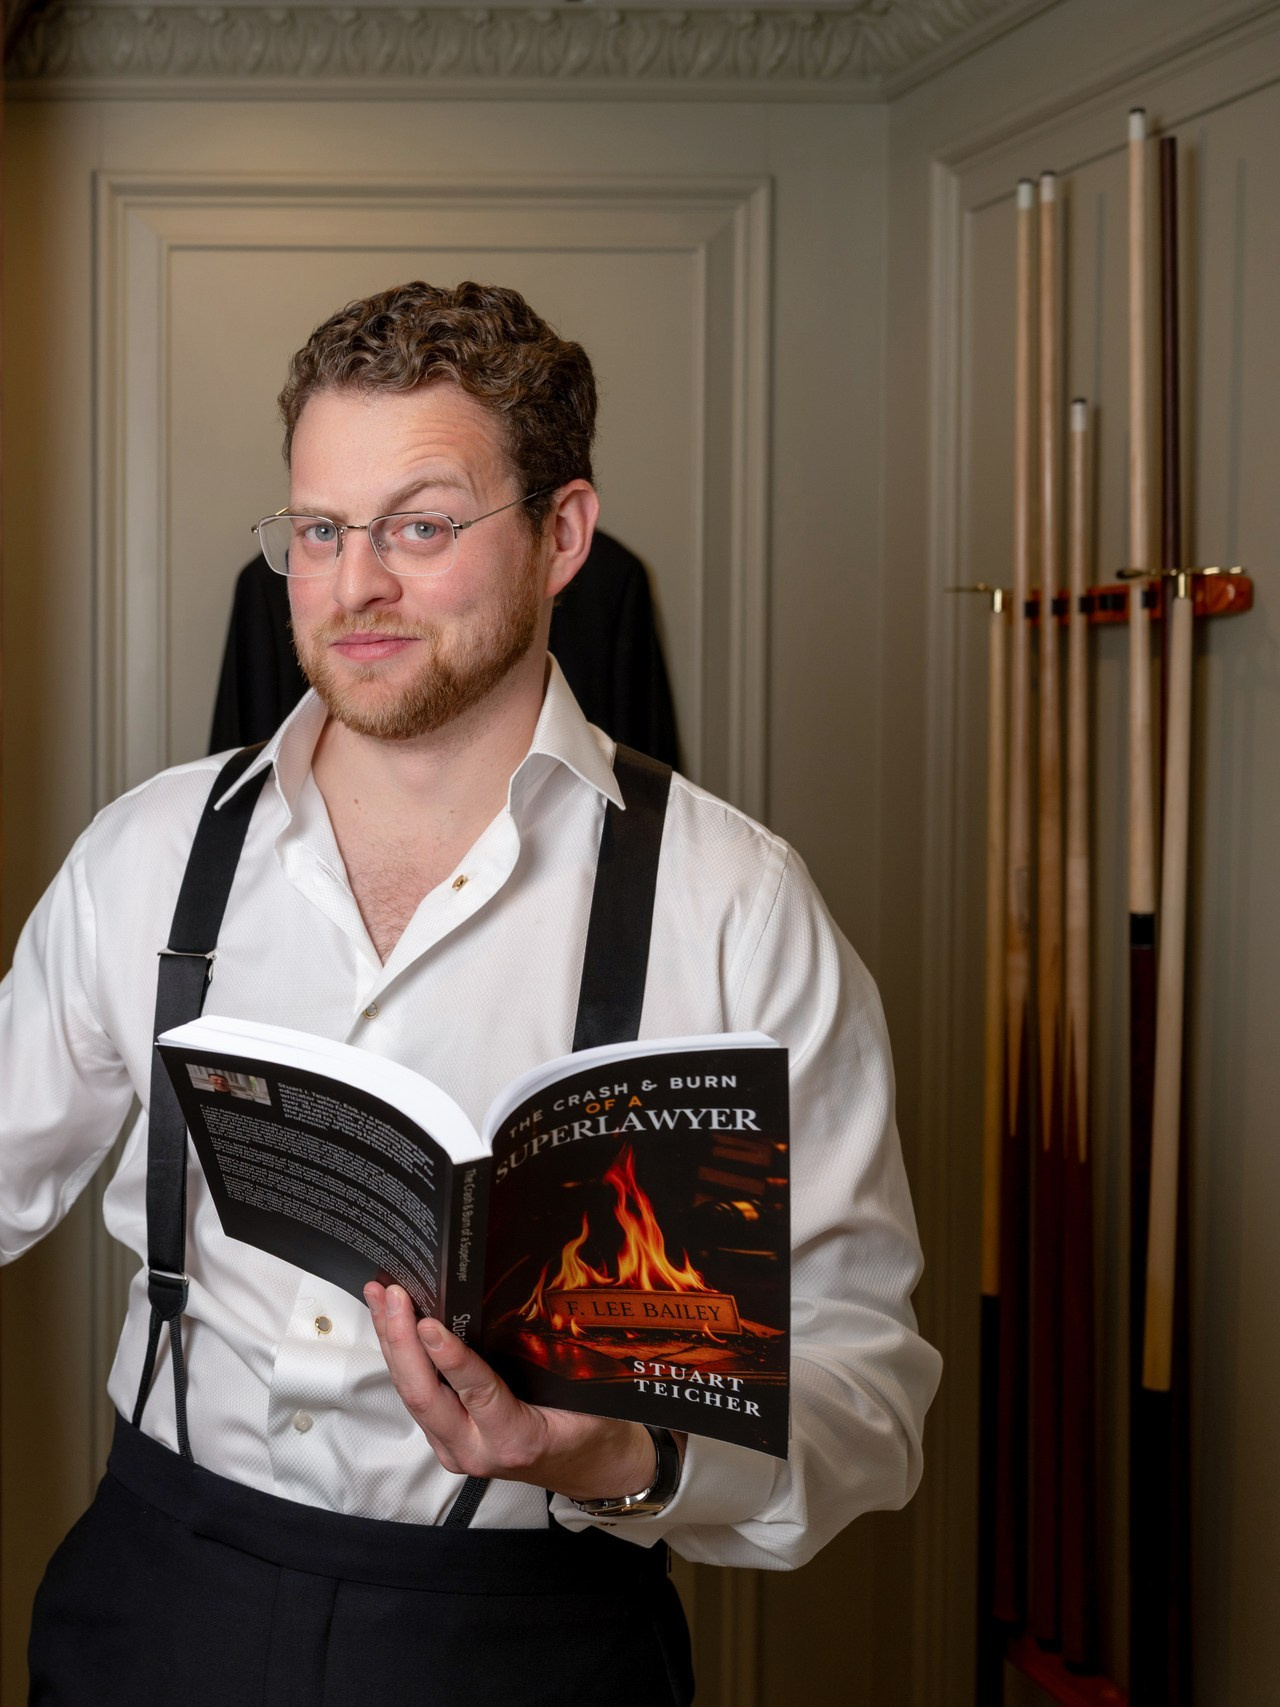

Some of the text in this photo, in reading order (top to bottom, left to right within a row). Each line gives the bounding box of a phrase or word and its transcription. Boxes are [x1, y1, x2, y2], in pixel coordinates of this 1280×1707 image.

[278, 1082, 302, 1093] Stuart
[312, 1092, 342, 1106] Teicher,
[343, 1102, 360, 1114] Esq.
[279, 1087, 314, 1102] educator
[316, 1098, 333, 1108] who
[335, 1104, 364, 1122] focuses
[509, 1075, 737, 1138] THE CRASH & BURN
[585, 1096, 643, 1114] OF A
[280, 1092, 308, 1105] writing
[310, 1101, 355, 1123] instruction.
[365, 1123, 400, 1149] practicing
[281, 1097, 298, 1106] over
[312, 1106, 336, 1119] years,
[337, 1115, 366, 1133] Stuart's
[368, 1129, 390, 1147] career
[282, 1102, 321, 1119] dedicated
[333, 1119, 362, 1136] helping
[363, 1132, 386, 1149] fellow
[283, 1107, 296, 1115] the
[298, 1112, 329, 1127] practice
[341, 1127, 354, 1137] law
[356, 1134, 370, 1145] and
[371, 1141, 392, 1159] thrive
[284, 1112, 328, 1131] profession.
[496, 1108, 762, 1184] SUPERLAWYER
[464, 1168, 477, 1183] The
[463, 1184, 475, 1203] Crash
[462, 1211, 473, 1228] Burn
[456, 1242, 471, 1282] Superlawyer
[567, 1301, 721, 1321] F. LEE BAILEY
[633, 1361, 744, 1393] STUART
[633, 1379, 762, 1417] TEICHER
